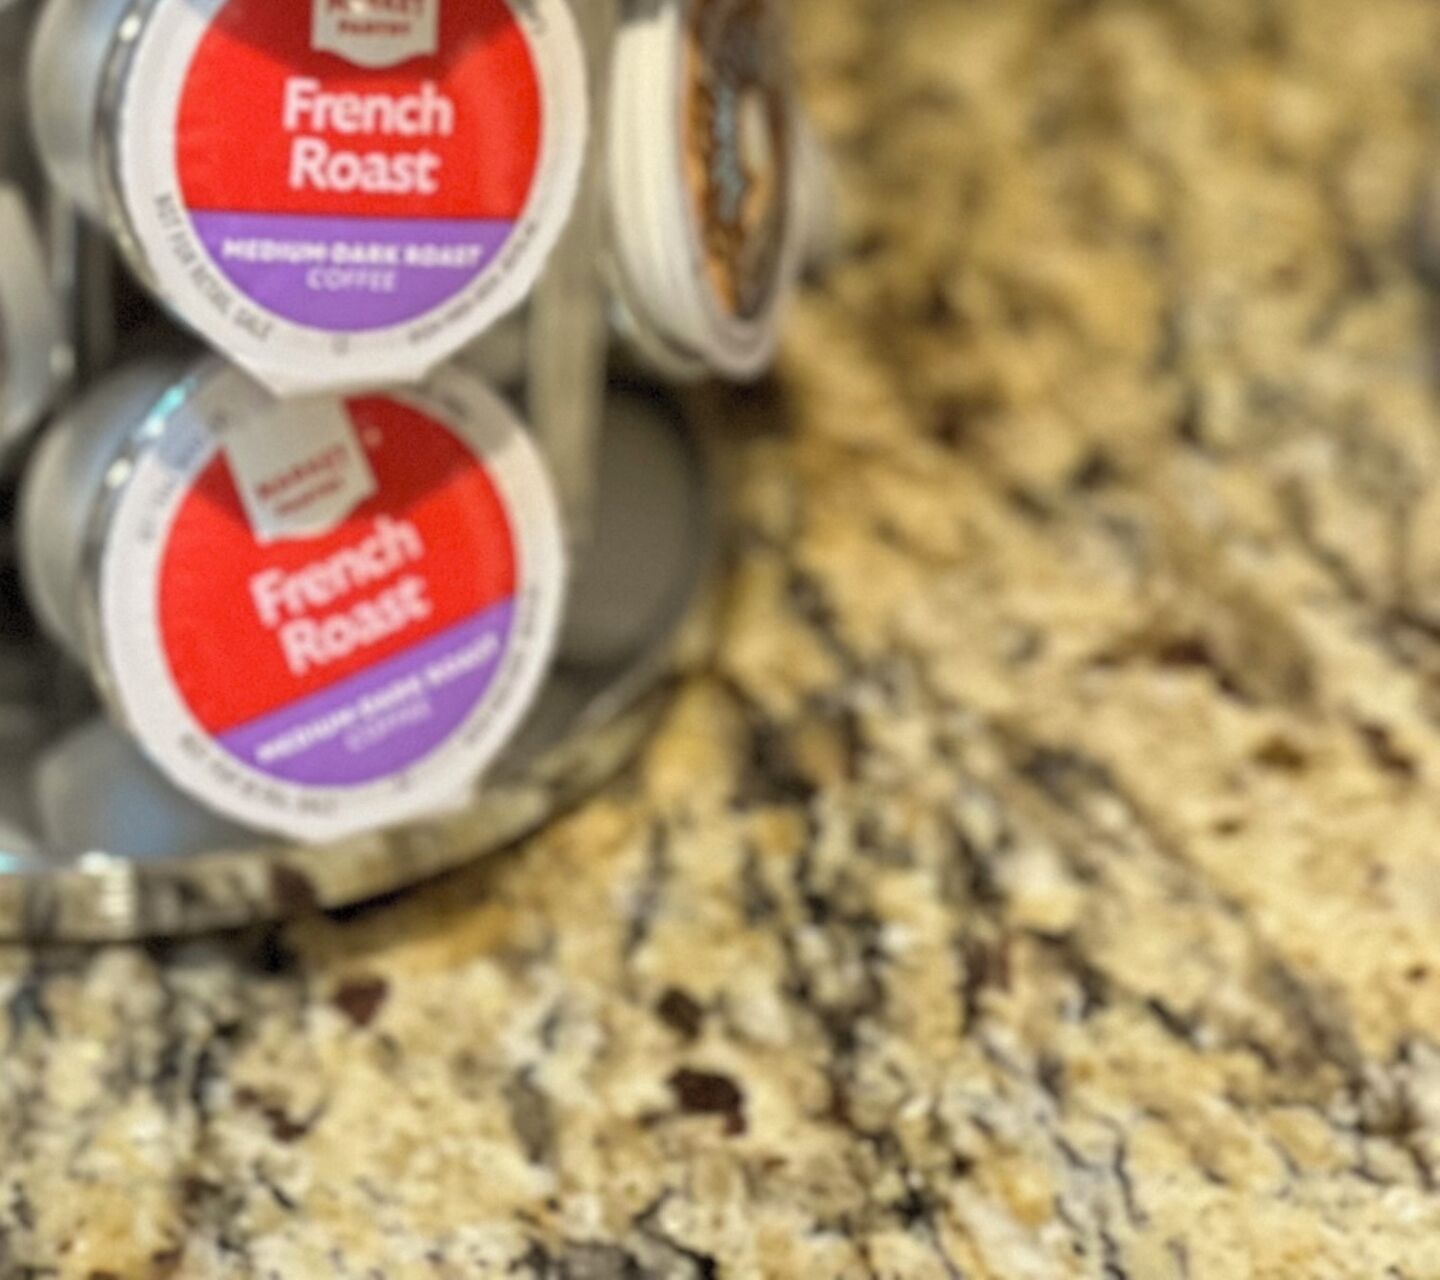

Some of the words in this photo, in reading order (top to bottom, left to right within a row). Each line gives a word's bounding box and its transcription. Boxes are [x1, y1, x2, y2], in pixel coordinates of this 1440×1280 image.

[282, 76, 454, 137] French
[289, 138, 441, 194] Roast
[249, 513, 425, 628] French
[278, 575, 434, 676] Roast
